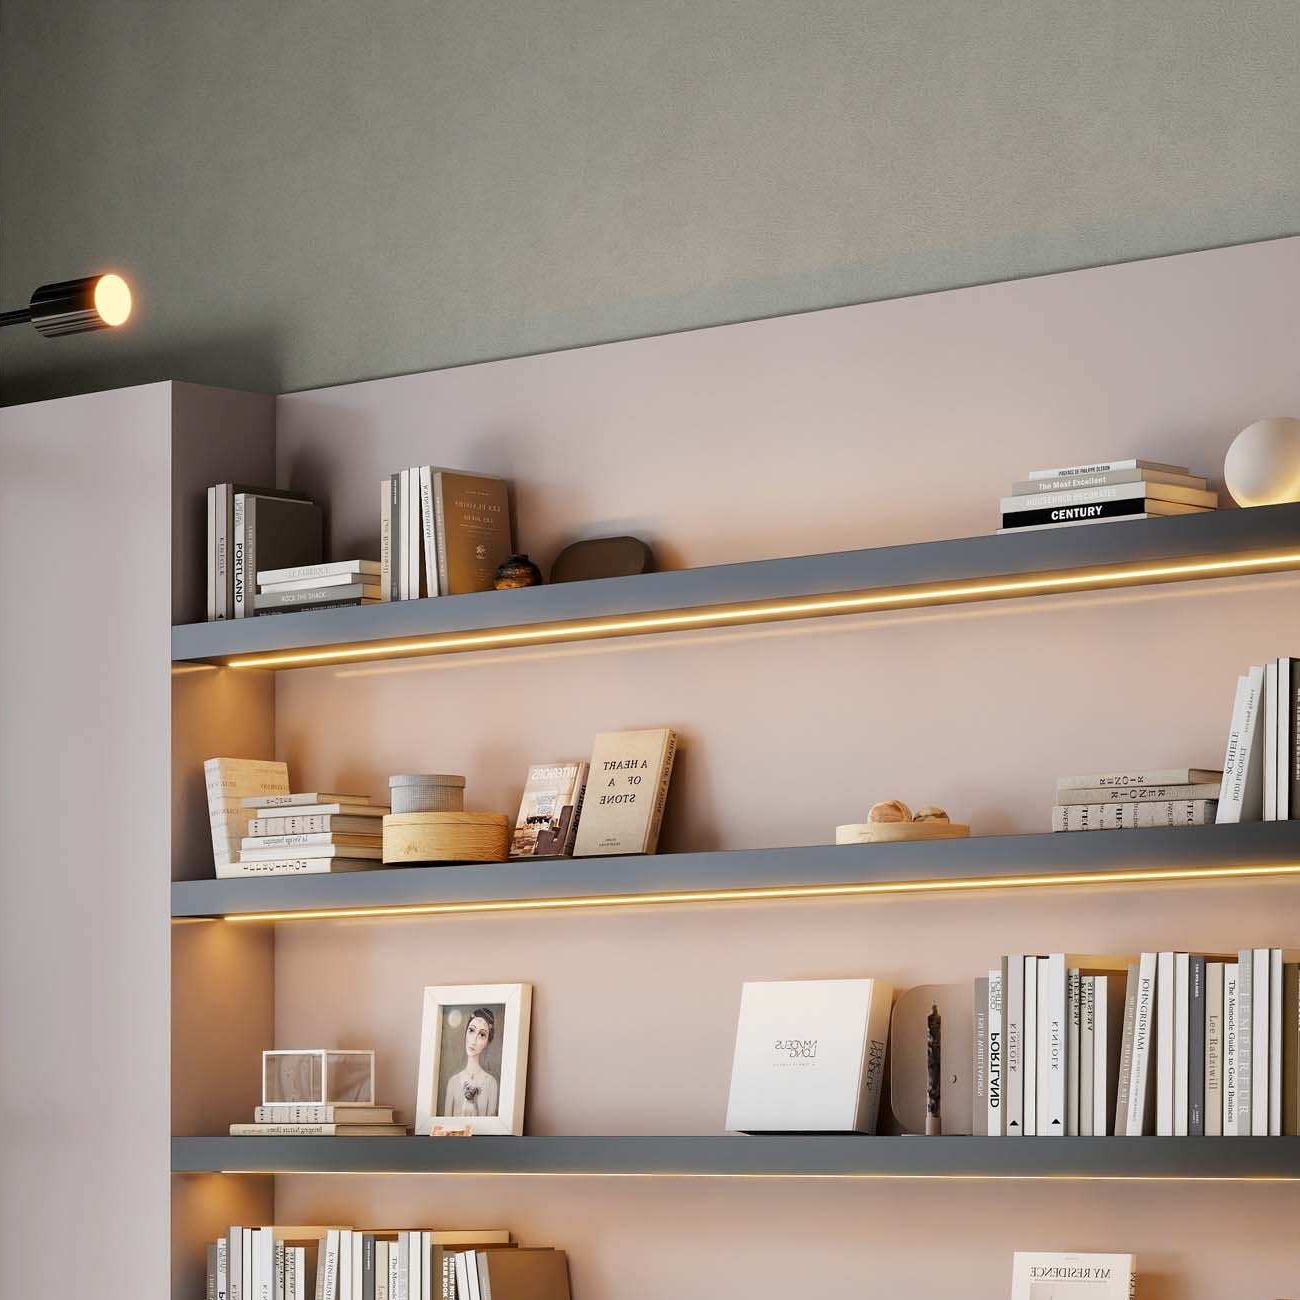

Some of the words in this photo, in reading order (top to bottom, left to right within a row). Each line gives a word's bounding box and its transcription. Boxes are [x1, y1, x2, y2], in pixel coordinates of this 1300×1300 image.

[1039, 482, 1051, 491] The
[1053, 480, 1071, 489] Most
[1073, 476, 1107, 487] Excellent
[1051, 505, 1103, 520] CENTURY
[235, 543, 243, 603] PORTLAND
[1226, 731, 1239, 775] SCHIELE
[1210, 1015, 1218, 1034] Lee
[1228, 998, 1236, 1031] Monocle
[1209, 1038, 1218, 1090] Radziwill
[1228, 1058, 1234, 1066] to
[1227, 1091, 1235, 1123] Business
